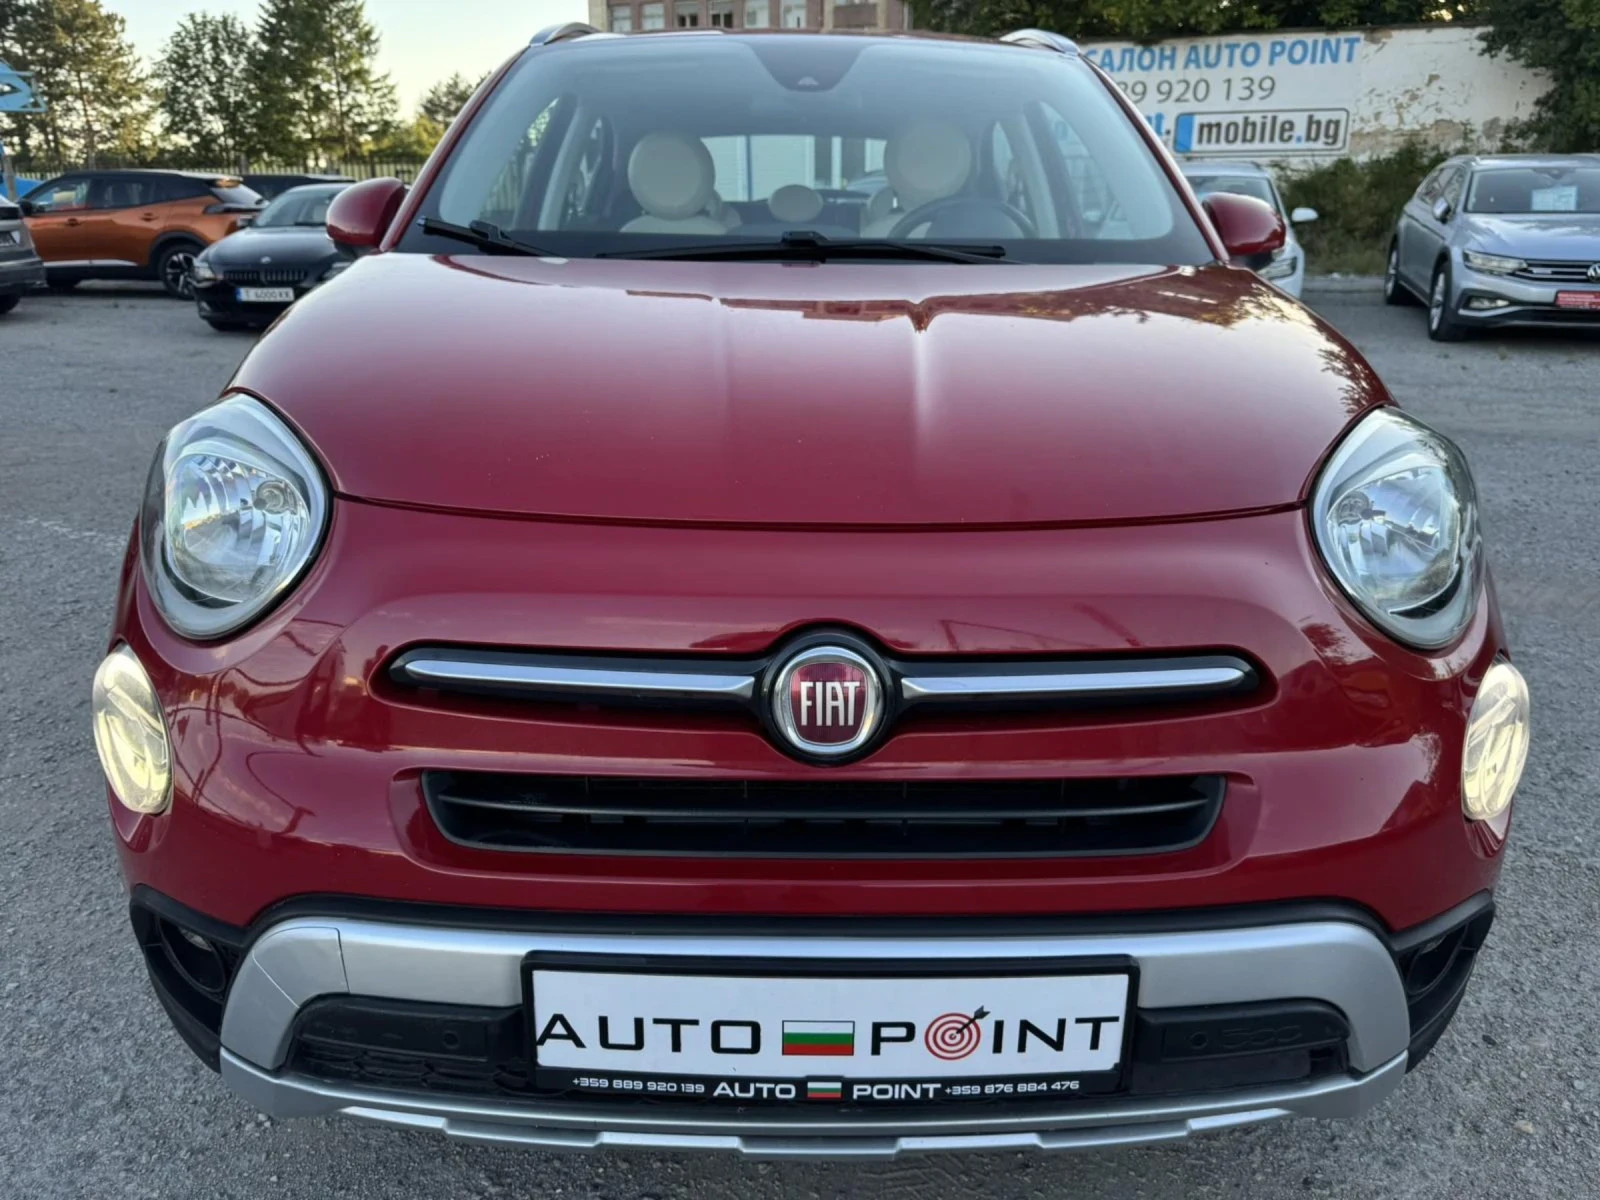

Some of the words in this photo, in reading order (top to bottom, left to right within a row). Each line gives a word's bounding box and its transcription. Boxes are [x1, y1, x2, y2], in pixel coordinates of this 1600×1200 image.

[1183, 42, 1261, 70] AUTO
[1268, 37, 1361, 66] POINT
[1156, 78, 1210, 103] 920
[1223, 75, 1276, 102] 139
[1197, 114, 1341, 146] mobile.bg
[800, 681, 860, 727] FIAT
[536, 1013, 761, 1055] AUTO
[572, 1077, 609, 1088] +359
[612, 1079, 643, 1090] 889
[647, 1081, 677, 1092] 920
[681, 1083, 705, 1094] 139
[712, 1082, 796, 1099] AUTO
[852, 1083, 942, 1100] POINT
[944, 1085, 981, 1096] +359
[984, 1083, 1014, 1094] 876
[1017, 1081, 1048, 1092] 884
[1051, 1080, 1080, 1091] 476
